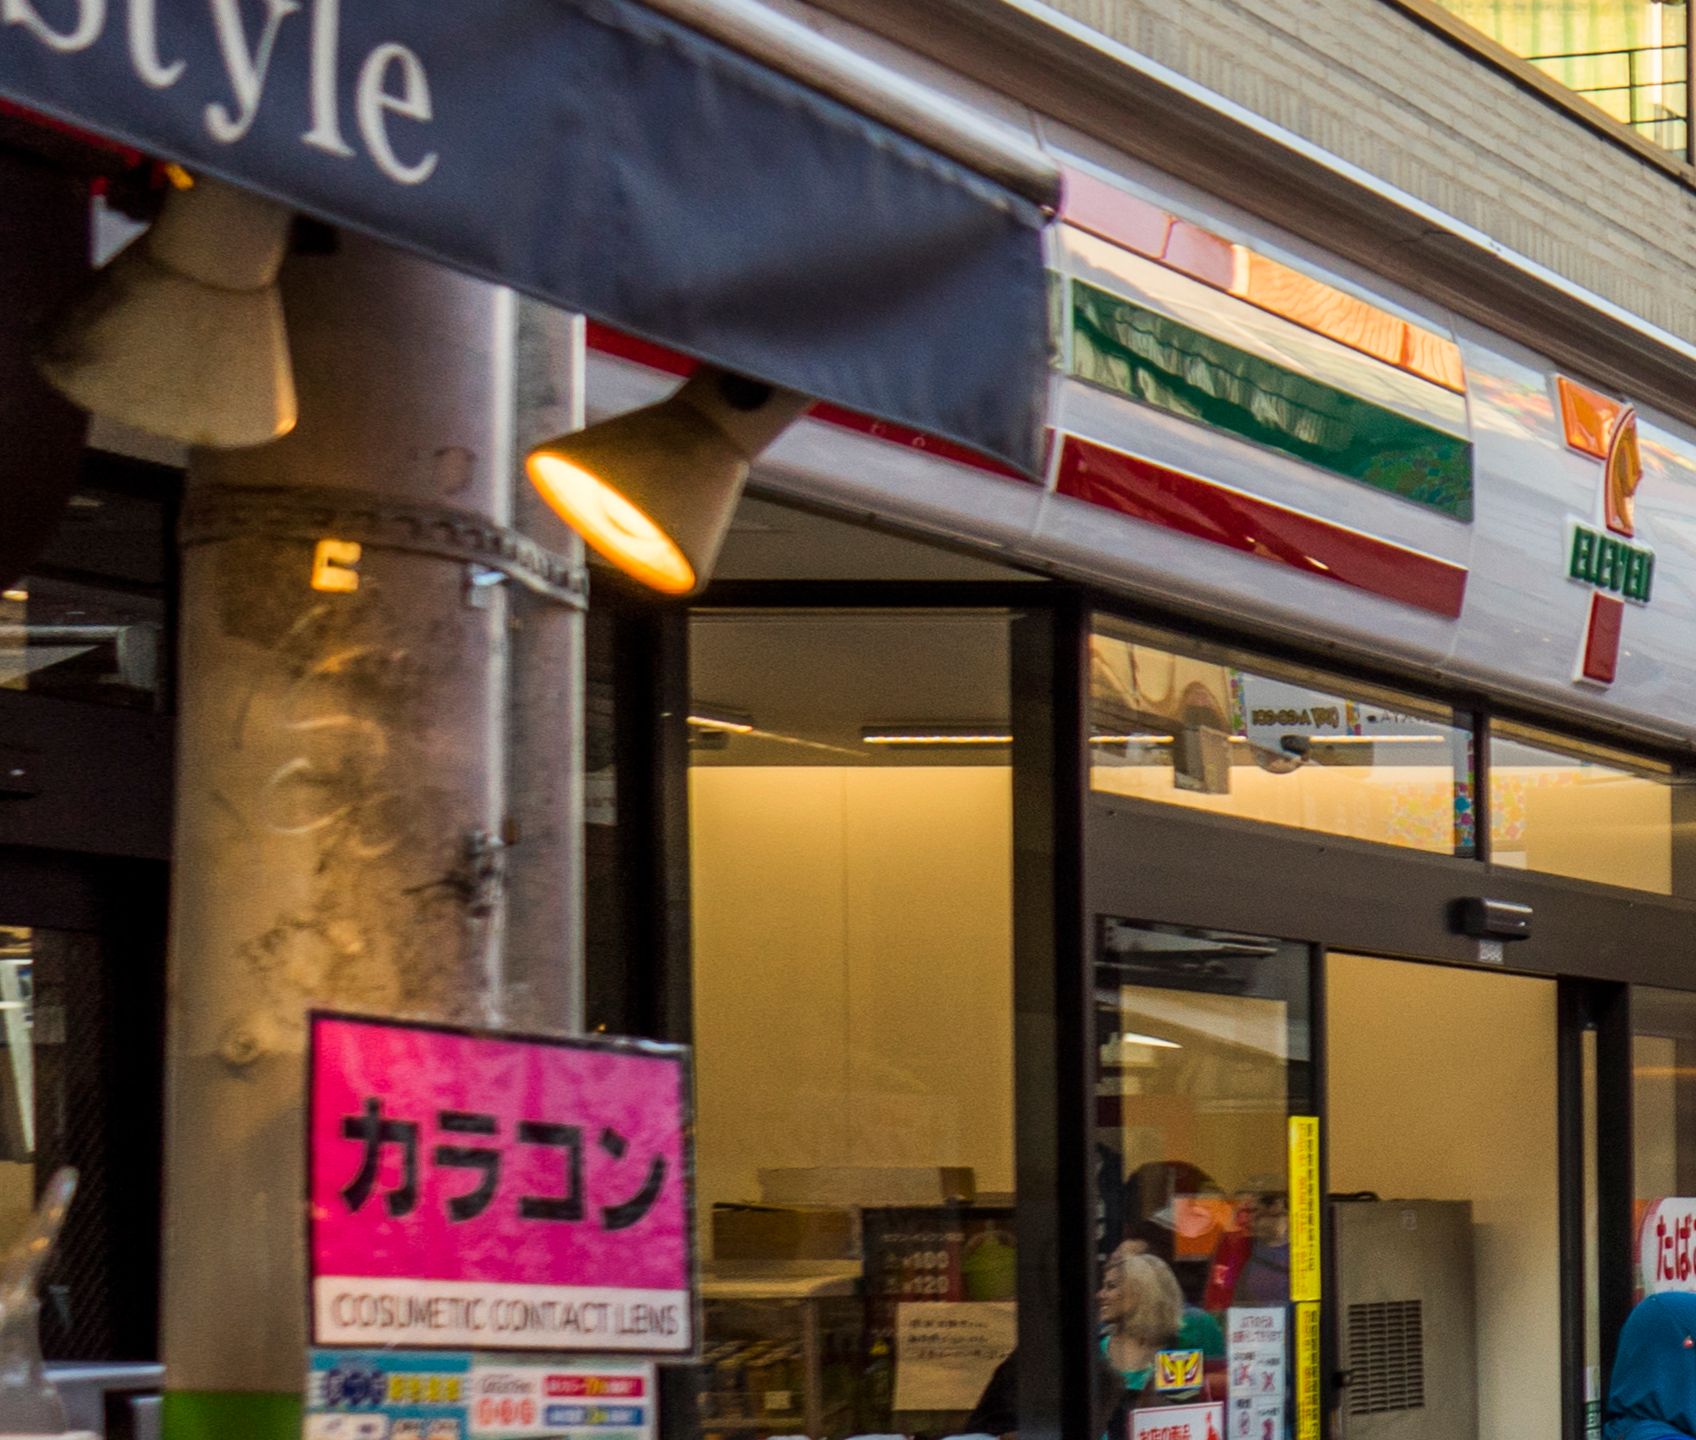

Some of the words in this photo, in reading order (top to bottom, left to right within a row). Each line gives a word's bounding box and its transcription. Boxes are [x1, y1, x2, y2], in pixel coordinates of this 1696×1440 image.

[339, 1097, 669, 1233] カラコン
[495, 1298, 606, 1334] CONTACT
[614, 1302, 681, 1337] LENS
